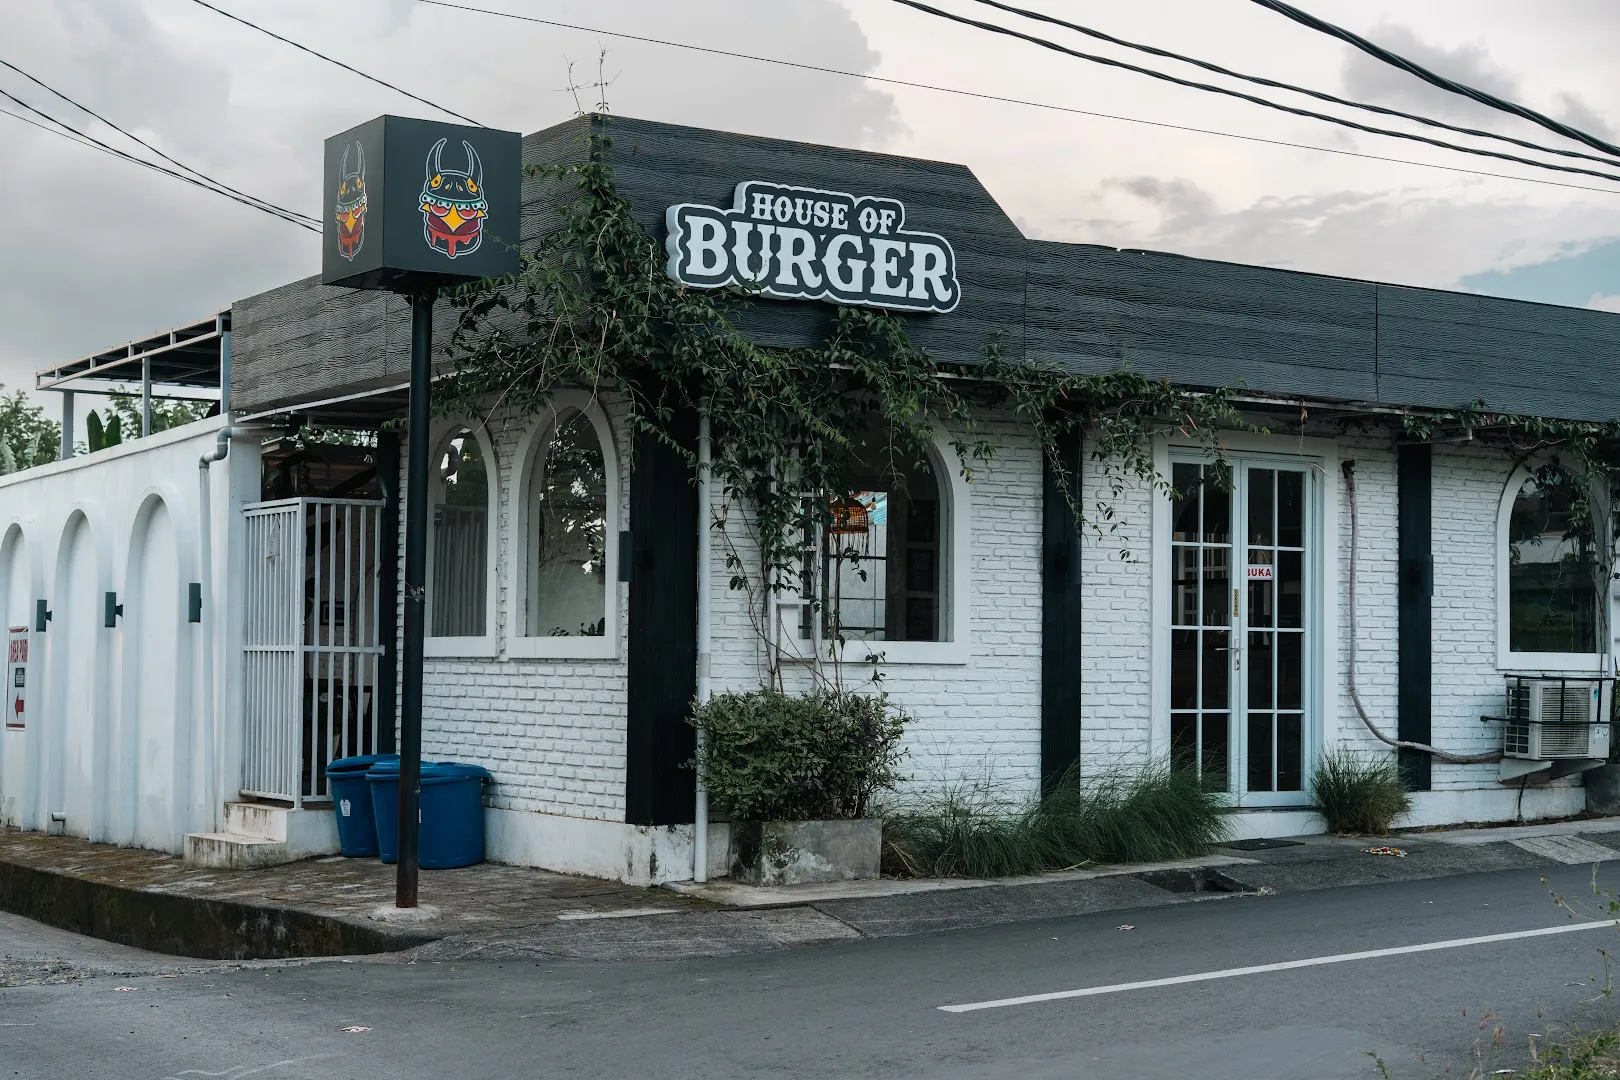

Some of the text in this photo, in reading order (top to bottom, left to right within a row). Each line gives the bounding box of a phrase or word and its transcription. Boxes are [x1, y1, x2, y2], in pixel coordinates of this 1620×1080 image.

[750, 192, 897, 235] HOUSE OF
[684, 215, 953, 303] BURGER
